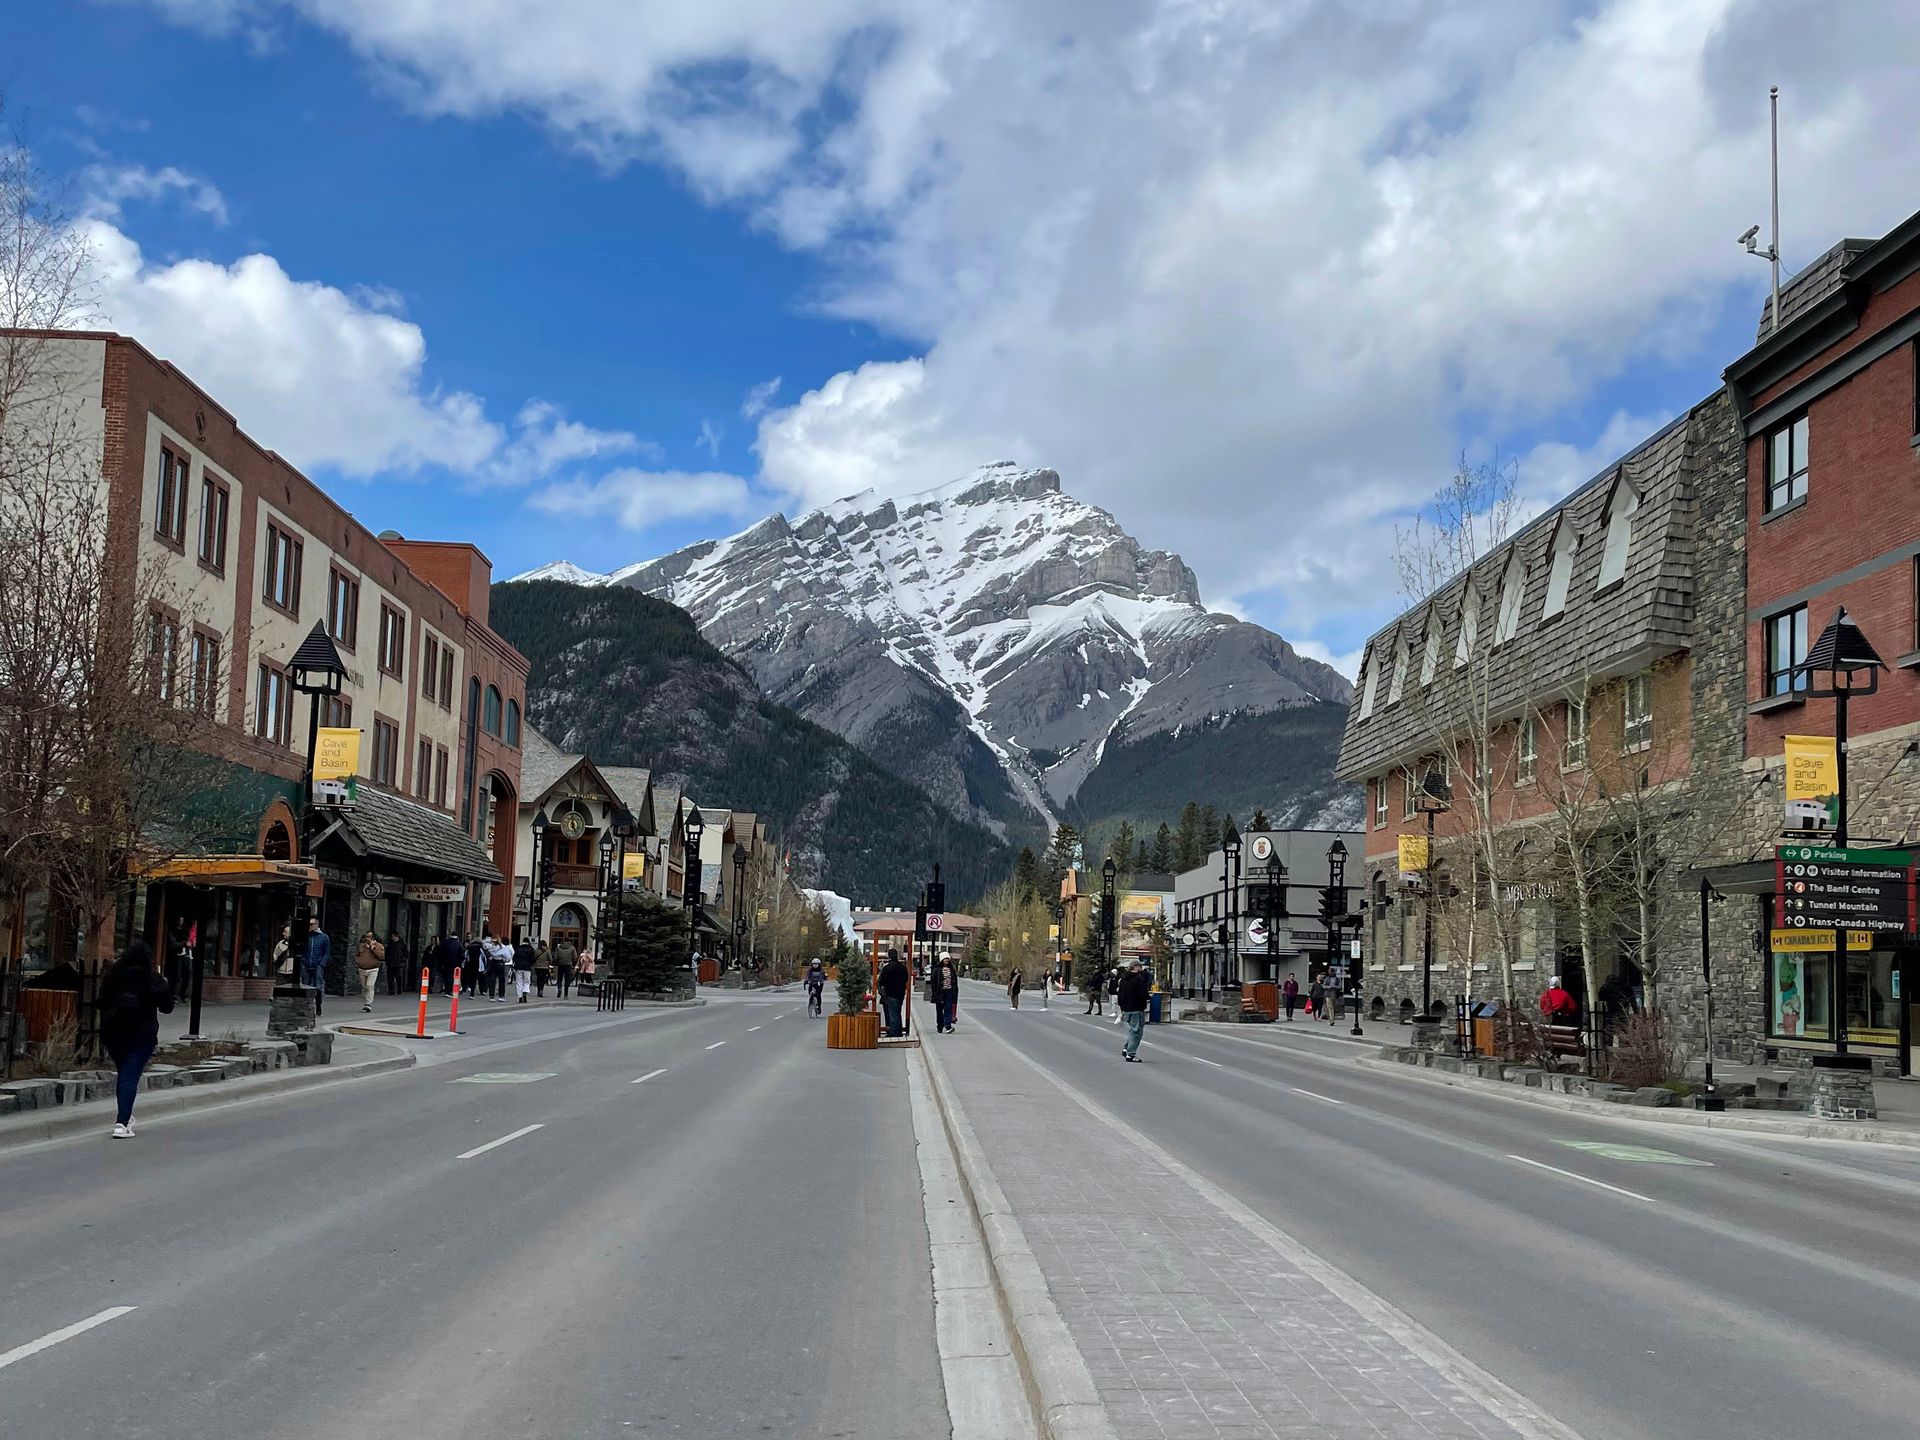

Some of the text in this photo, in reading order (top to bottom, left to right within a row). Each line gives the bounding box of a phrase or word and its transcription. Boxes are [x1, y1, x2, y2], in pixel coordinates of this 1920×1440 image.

[322, 738, 348, 748] Cave
[321, 749, 341, 757] and
[320, 757, 349, 768] Basin
[1793, 757, 1824, 768] Cave
[1794, 769, 1817, 779] and
[1794, 780, 1828, 792] Basin
[1814, 850, 1847, 862] Parking
[1820, 867, 1901, 879] Visitor Information
[407, 885, 431, 894] ROCKS
[441, 886, 461, 895] GEMS
[1809, 883, 1880, 895] The Banff Centre
[1809, 900, 1879, 912] Tunnel Mountain
[1808, 917, 1905, 931] Trans-Canada Highway
